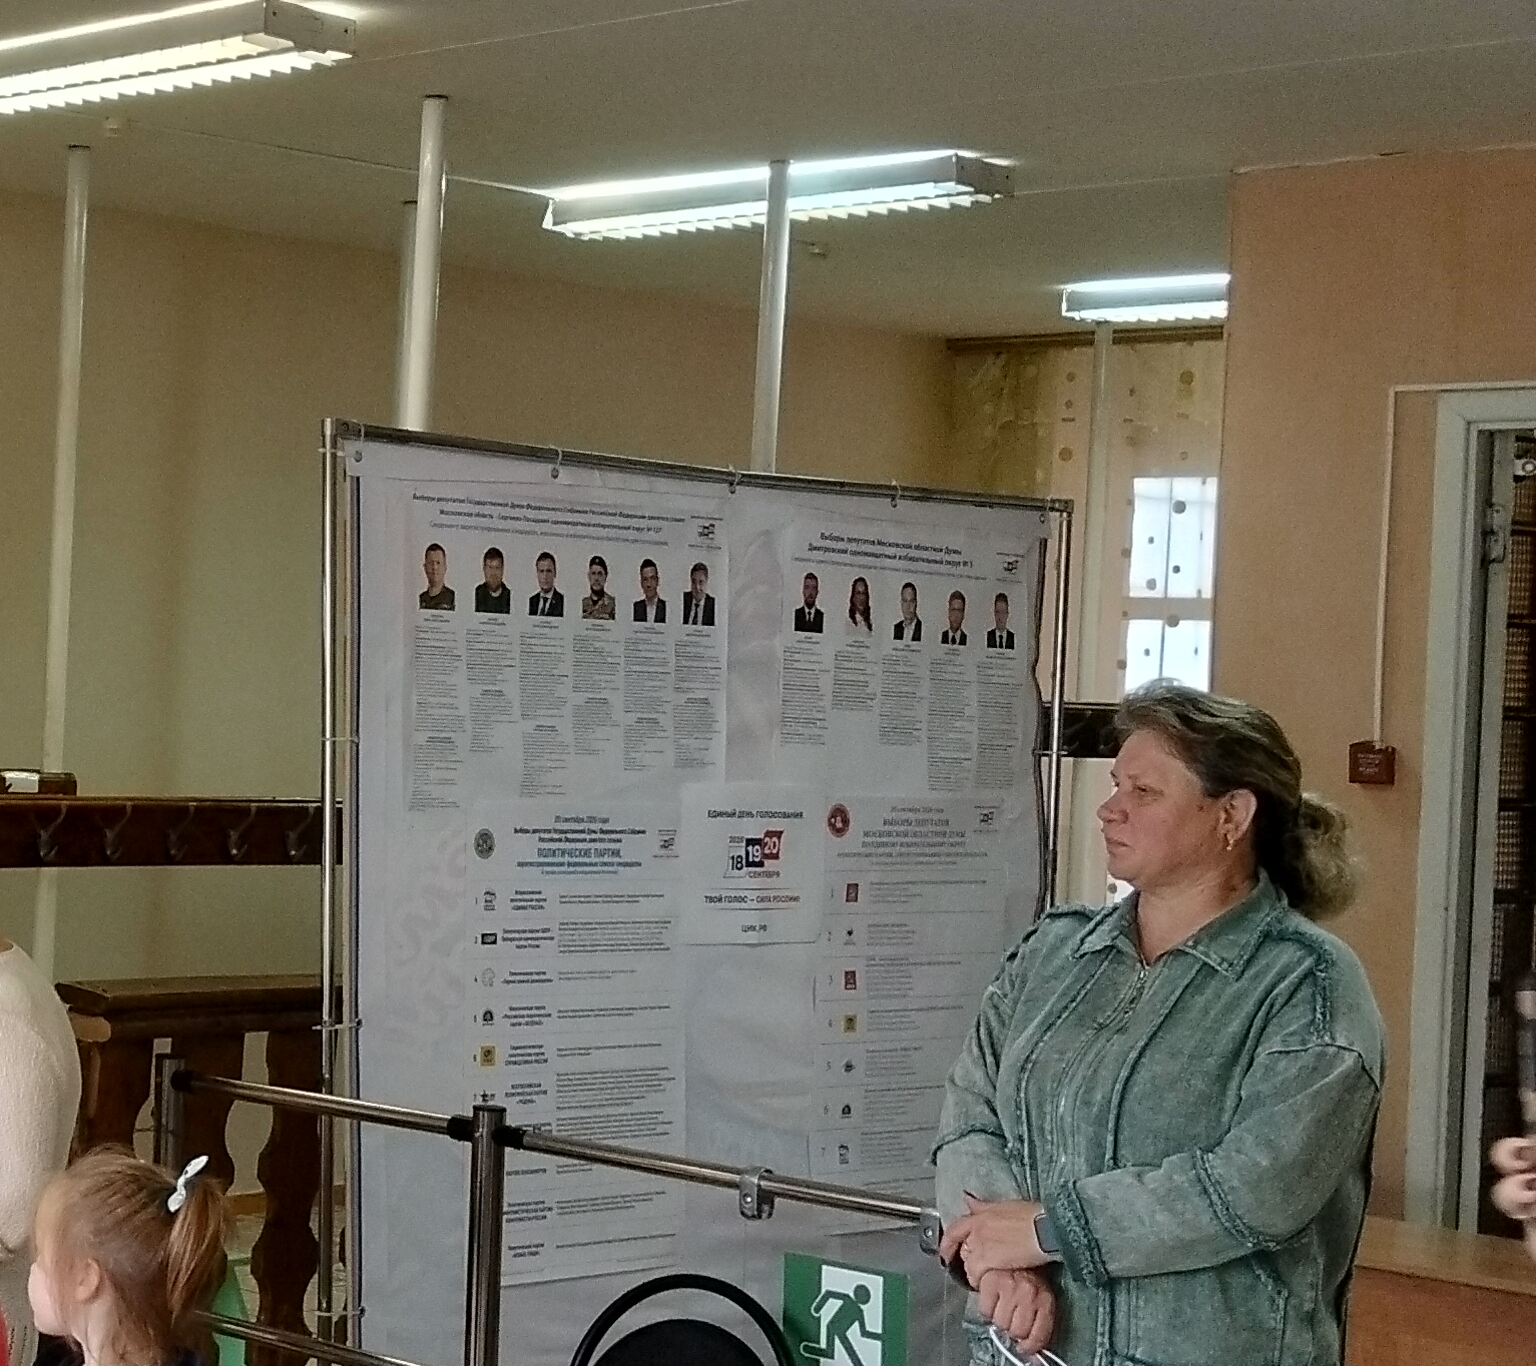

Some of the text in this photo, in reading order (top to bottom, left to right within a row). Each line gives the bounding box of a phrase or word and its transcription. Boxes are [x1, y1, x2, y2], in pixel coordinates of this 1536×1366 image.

[746, 845, 762, 862] 19
[764, 836, 779, 854] 20
[730, 855, 744, 871] 18
